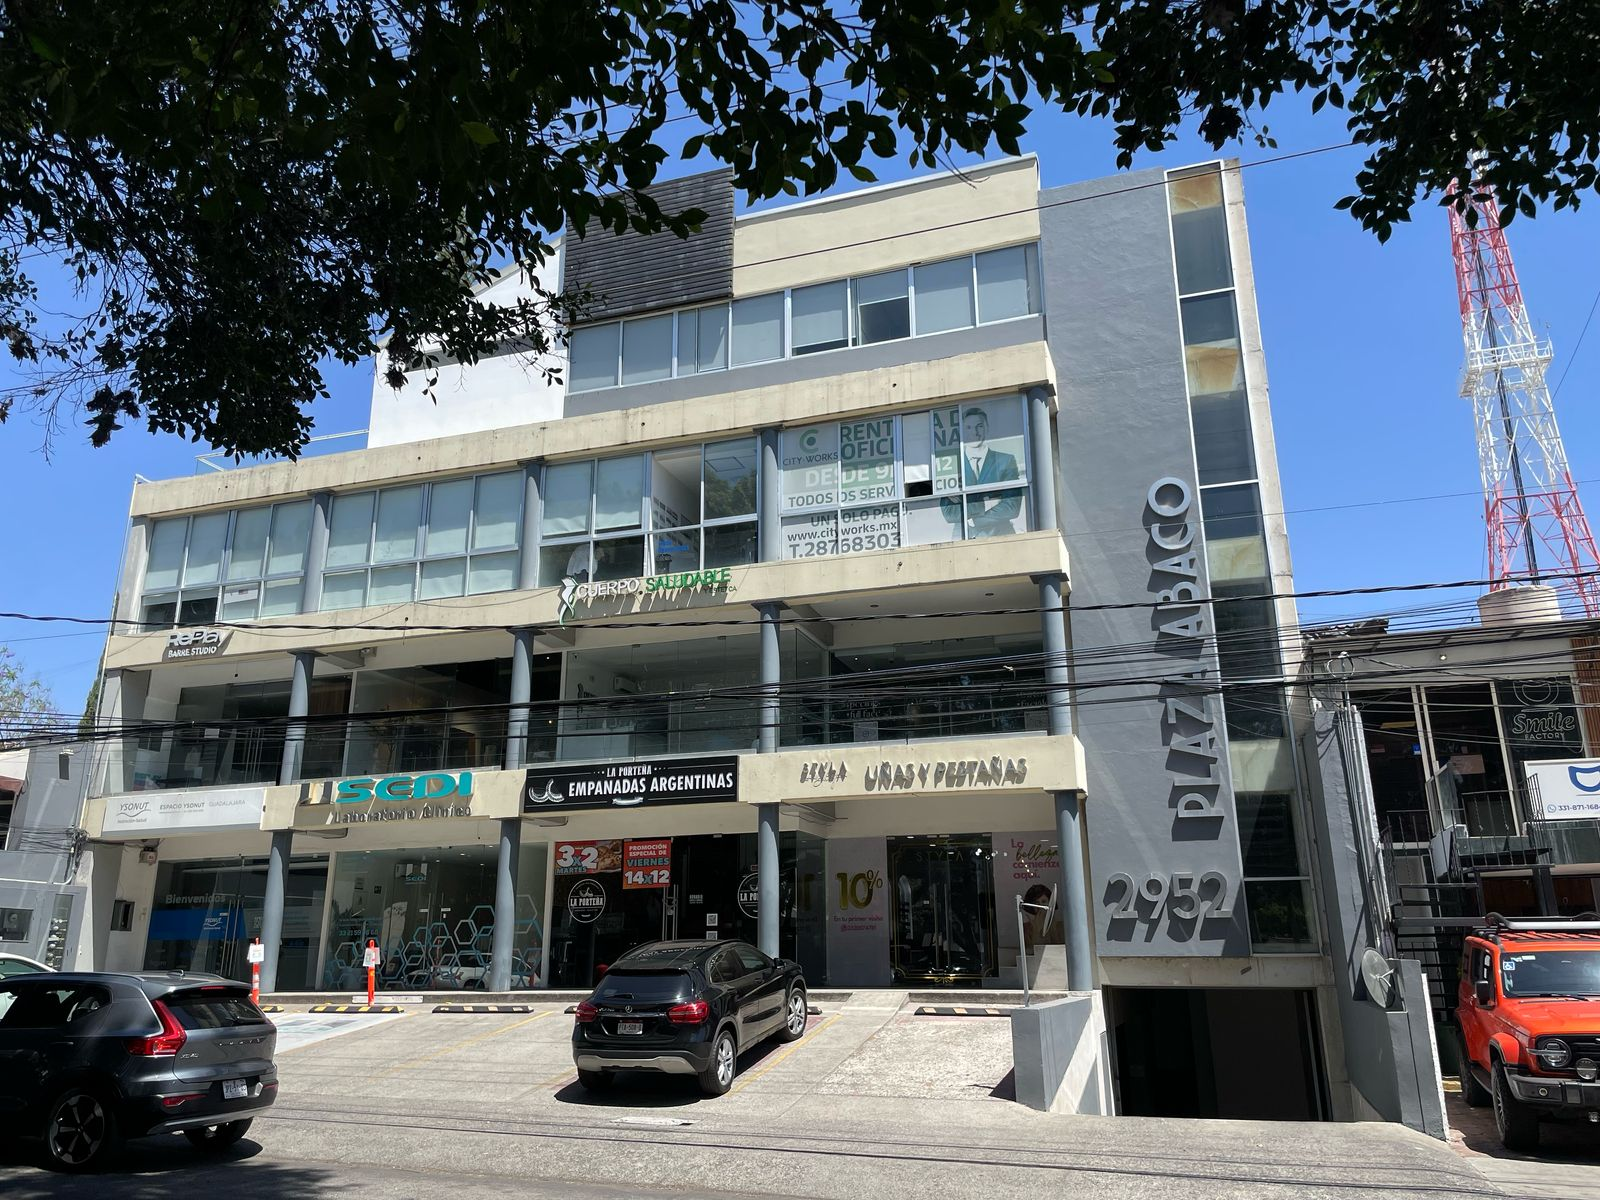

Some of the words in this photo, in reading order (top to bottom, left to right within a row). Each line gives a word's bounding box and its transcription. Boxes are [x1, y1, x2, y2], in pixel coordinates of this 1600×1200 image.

[782, 456, 803, 466] CITY
[806, 452, 839, 463] WORKS
[789, 492, 833, 507] TODOS
[811, 515, 829, 527] UN
[577, 578, 639, 598] CUERPO
[646, 568, 731, 592] SALUDABLE
[168, 649, 190, 658] BARRE
[191, 647, 217, 656] STUDIO
[1512, 712, 1575, 734] Smile
[1525, 732, 1564, 741] FACTORY
[607, 767, 616, 777] LA
[618, 764, 651, 777] PORTEÑA
[865, 761, 915, 791] UÑAS
[918, 763, 930, 788] Y
[934, 755, 1027, 788] PESTAÑAS
[336, 772, 472, 803] SEDI
[569, 778, 646, 797] EMPANADAS
[650, 773, 733, 793] ARGENTINAS
[119, 802, 149, 811] YSONUT
[160, 803, 182, 811] ESPACIO
[627, 858, 669, 867] VIERNES
[625, 870, 669, 884] 14x12
[166, 893, 225, 904] Bienvenidos
[1106, 870, 1233, 919] 2952
[570, 898, 577, 907] LA
